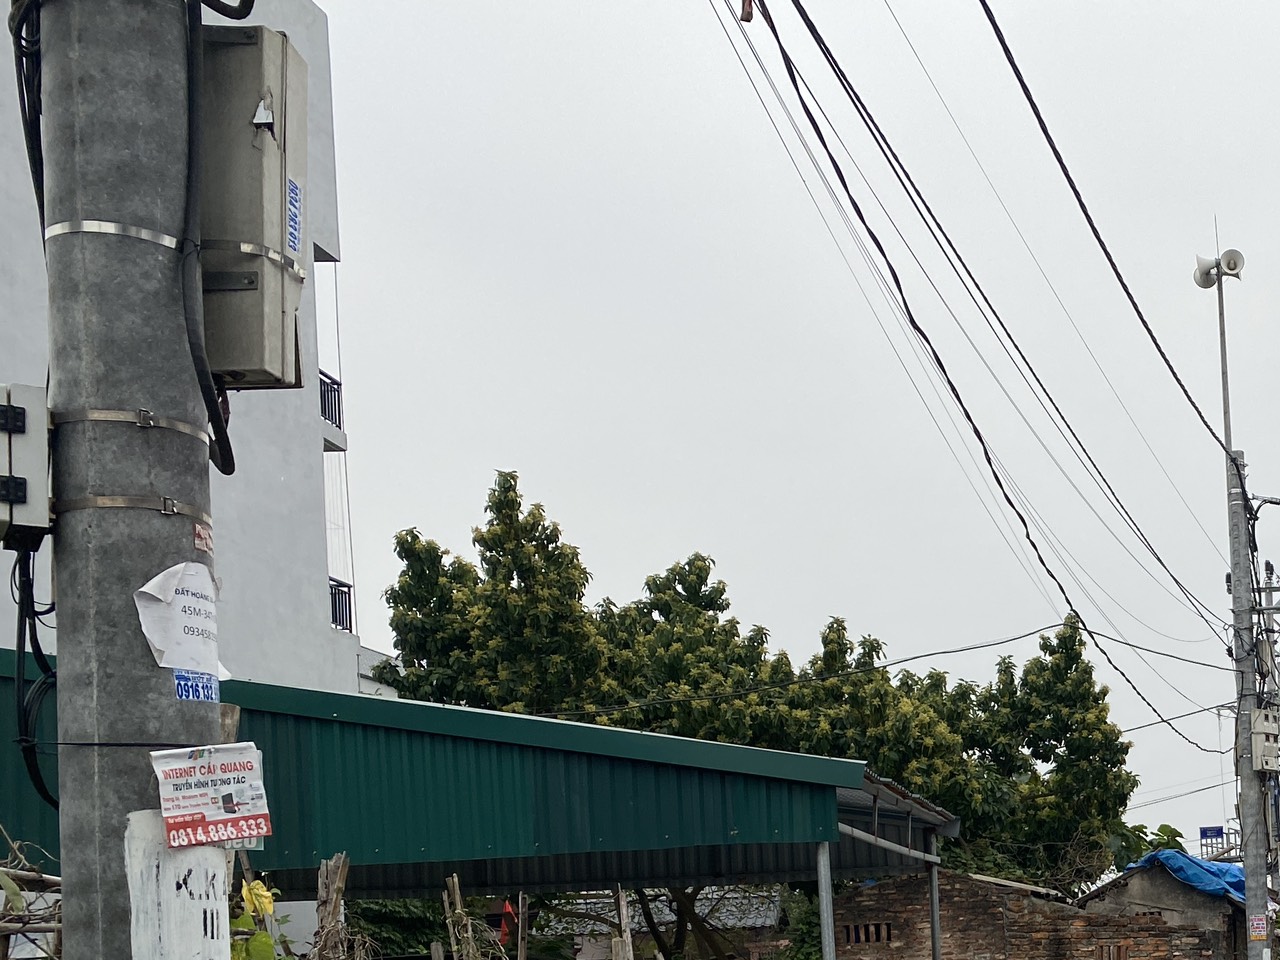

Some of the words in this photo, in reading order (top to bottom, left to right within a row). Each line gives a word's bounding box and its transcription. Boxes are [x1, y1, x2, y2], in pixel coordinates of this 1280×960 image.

[161, 766, 197, 780] INTERNET
[220, 761, 254, 774] QUANG
[233, 775, 246, 784] TÁC
[169, 818, 267, 847] 0814.886.333
